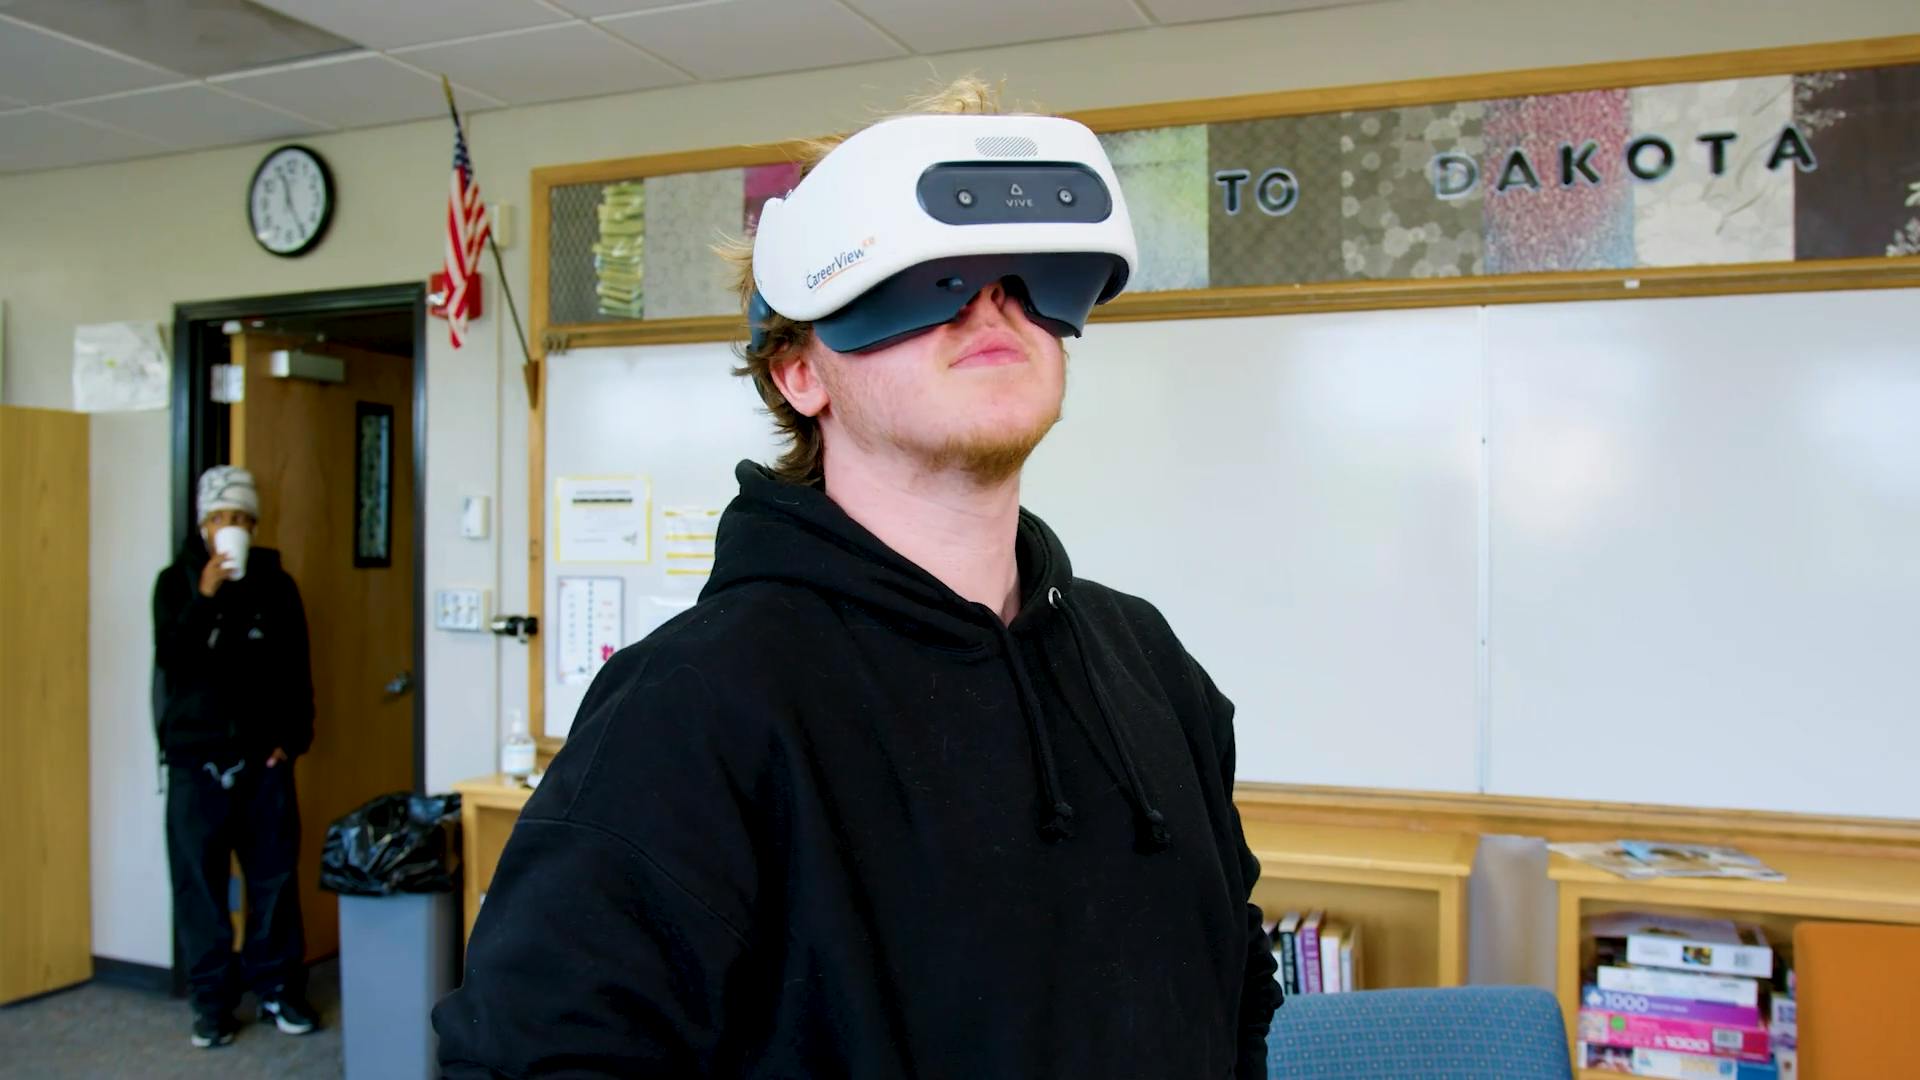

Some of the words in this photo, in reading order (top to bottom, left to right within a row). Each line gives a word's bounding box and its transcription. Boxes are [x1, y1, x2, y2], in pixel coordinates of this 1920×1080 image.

[1215, 168, 1299, 215] TO
[1434, 127, 1817, 198] DAKOTA
[1005, 199, 1033, 208] VIVE
[806, 247, 865, 289] CareerView
[1605, 993, 1649, 1013] 1000
